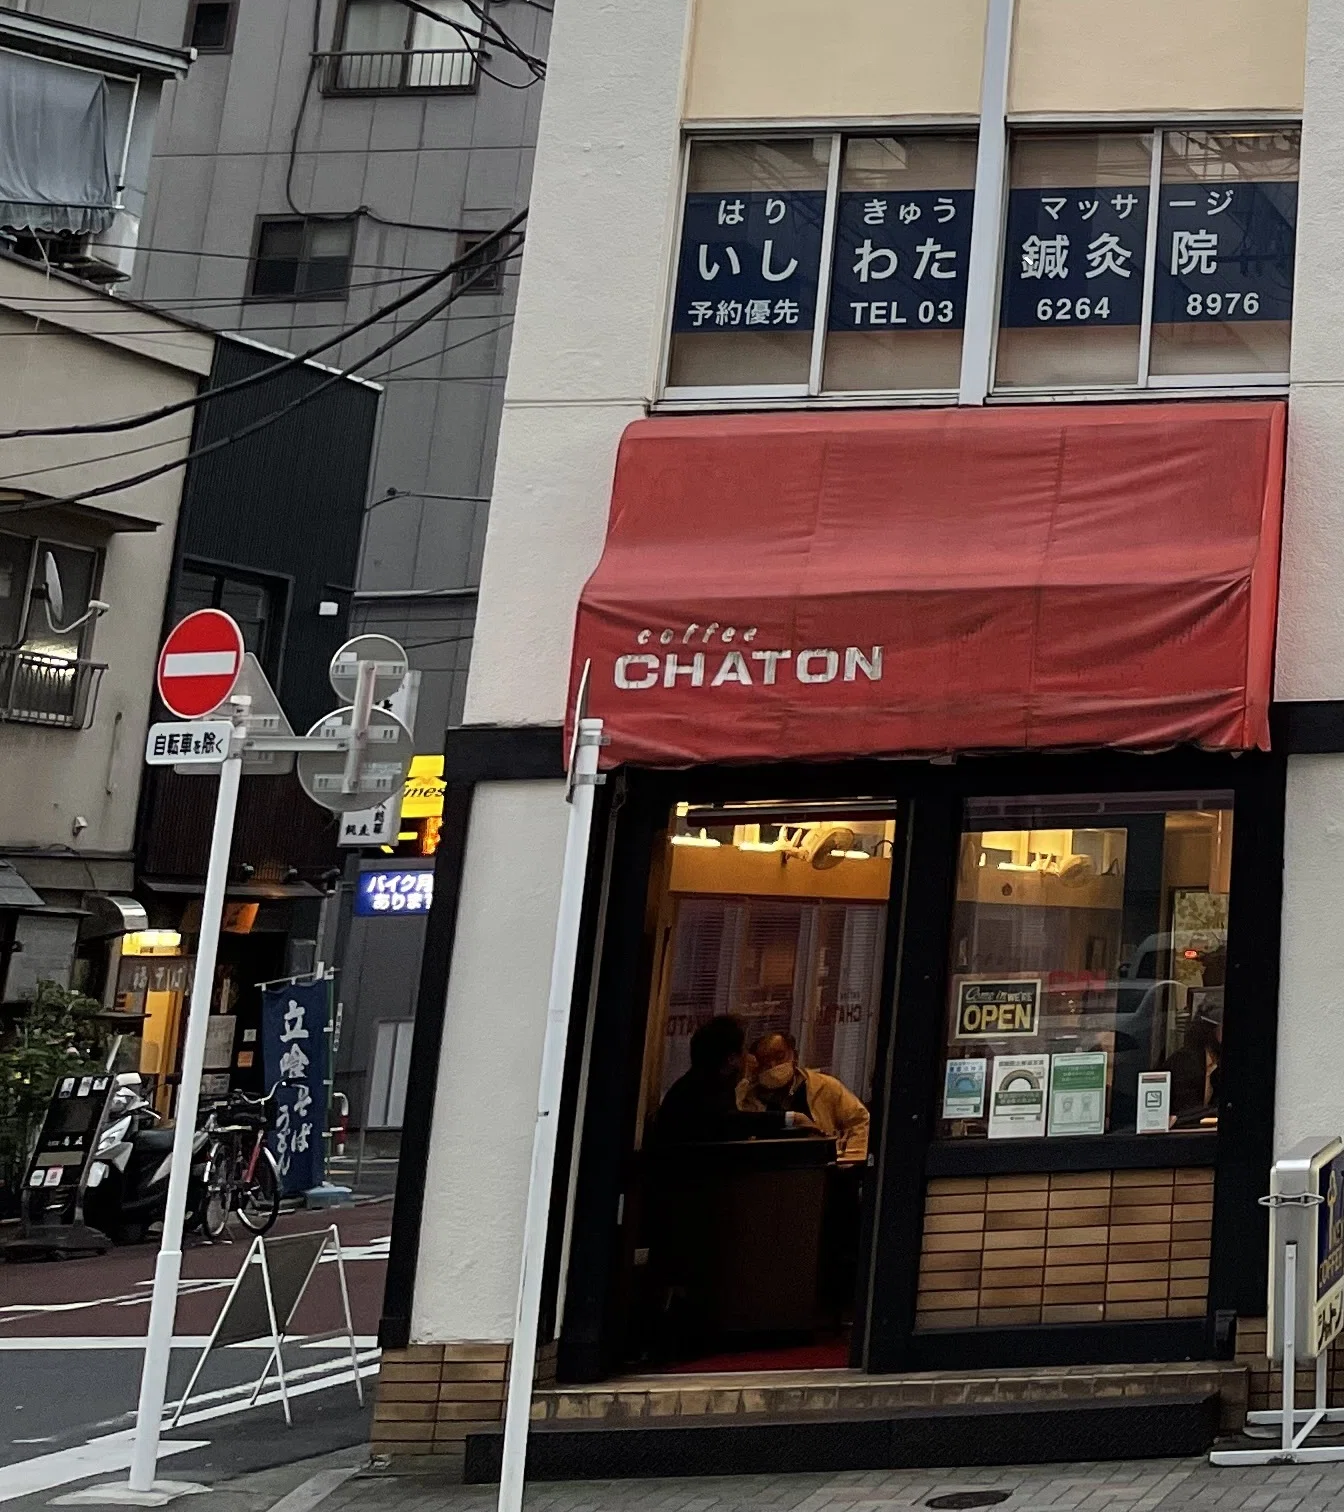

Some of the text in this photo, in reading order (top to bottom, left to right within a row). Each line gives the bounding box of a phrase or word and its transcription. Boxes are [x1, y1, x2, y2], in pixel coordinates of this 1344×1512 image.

[687, 292, 1260, 326] 予約優先 TEL 03 6264 8976
[637, 621, 758, 646] coffee
[614, 644, 885, 690] CHATON
[153, 730, 224, 757] 自転車を除く
[404, 784, 446, 798] imes
[963, 1003, 1032, 1031] OPEN
